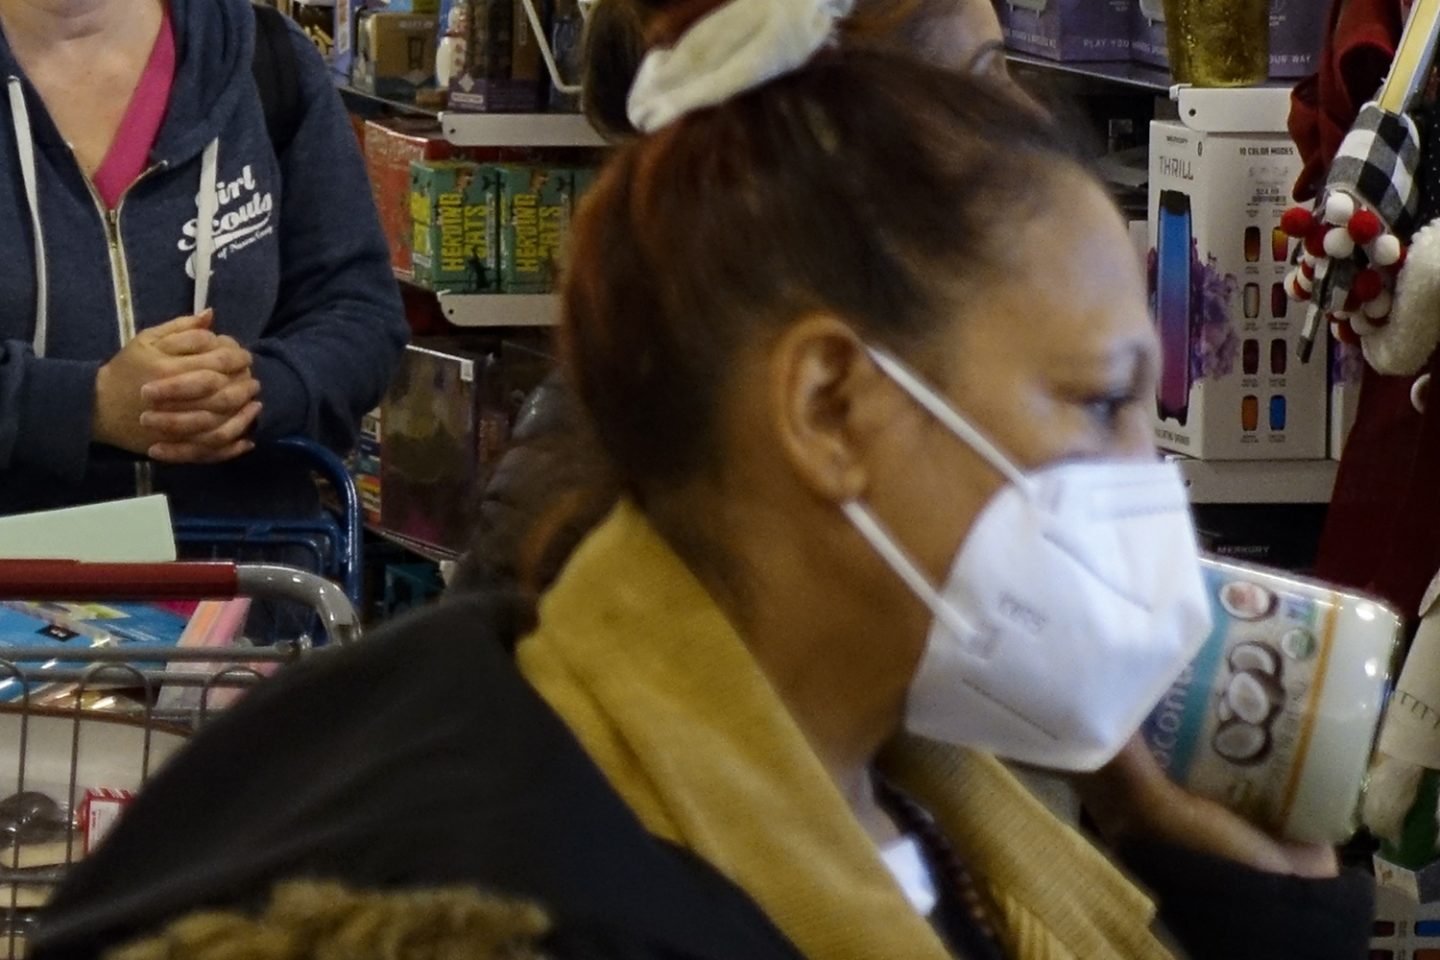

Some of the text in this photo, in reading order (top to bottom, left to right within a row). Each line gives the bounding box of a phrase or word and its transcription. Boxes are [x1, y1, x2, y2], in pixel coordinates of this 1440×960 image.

[1159, 155, 1195, 182] THRILL
[440, 192, 465, 272] HERDING
[464, 204, 487, 259] CATS
[514, 193, 540, 273] HERDING
